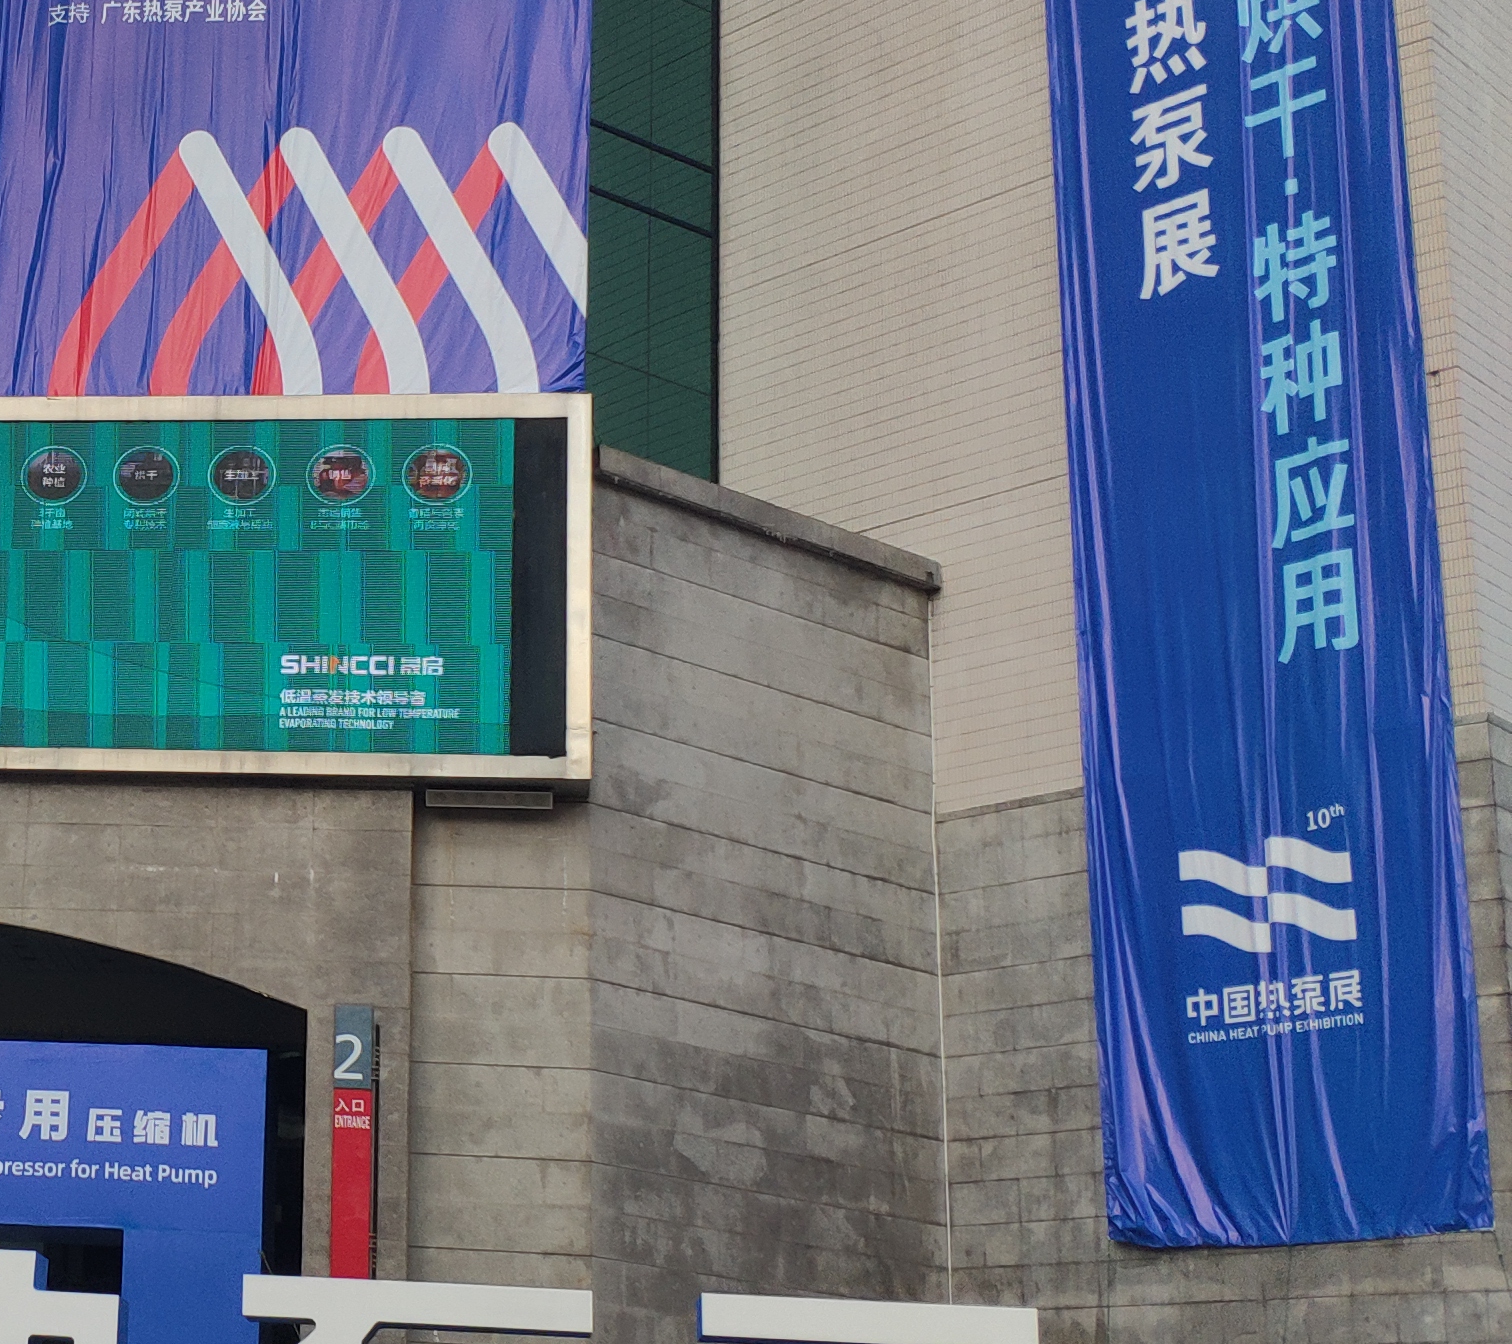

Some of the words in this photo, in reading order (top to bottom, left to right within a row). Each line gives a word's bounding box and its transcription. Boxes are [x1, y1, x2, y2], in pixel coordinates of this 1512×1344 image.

[48, 2, 90, 27] 支持
[280, 654, 396, 676] SHINCCI
[1305, 802, 1346, 832] 10th
[1186, 969, 1364, 1026] 中国热泵展
[1188, 1028, 1227, 1044] CHINA
[1229, 1025, 1258, 1041] HEAT
[1261, 1021, 1292, 1037] PUMP
[1296, 1012, 1364, 1033] EXHIBITION
[333, 1033, 363, 1080] 2
[334, 1097, 365, 1113] 入口
[334, 1114, 370, 1130] ENTRANCE
[70, 1159, 99, 1180] for
[104, 1162, 152, 1182] Heat
[157, 1163, 218, 1188] Pump
